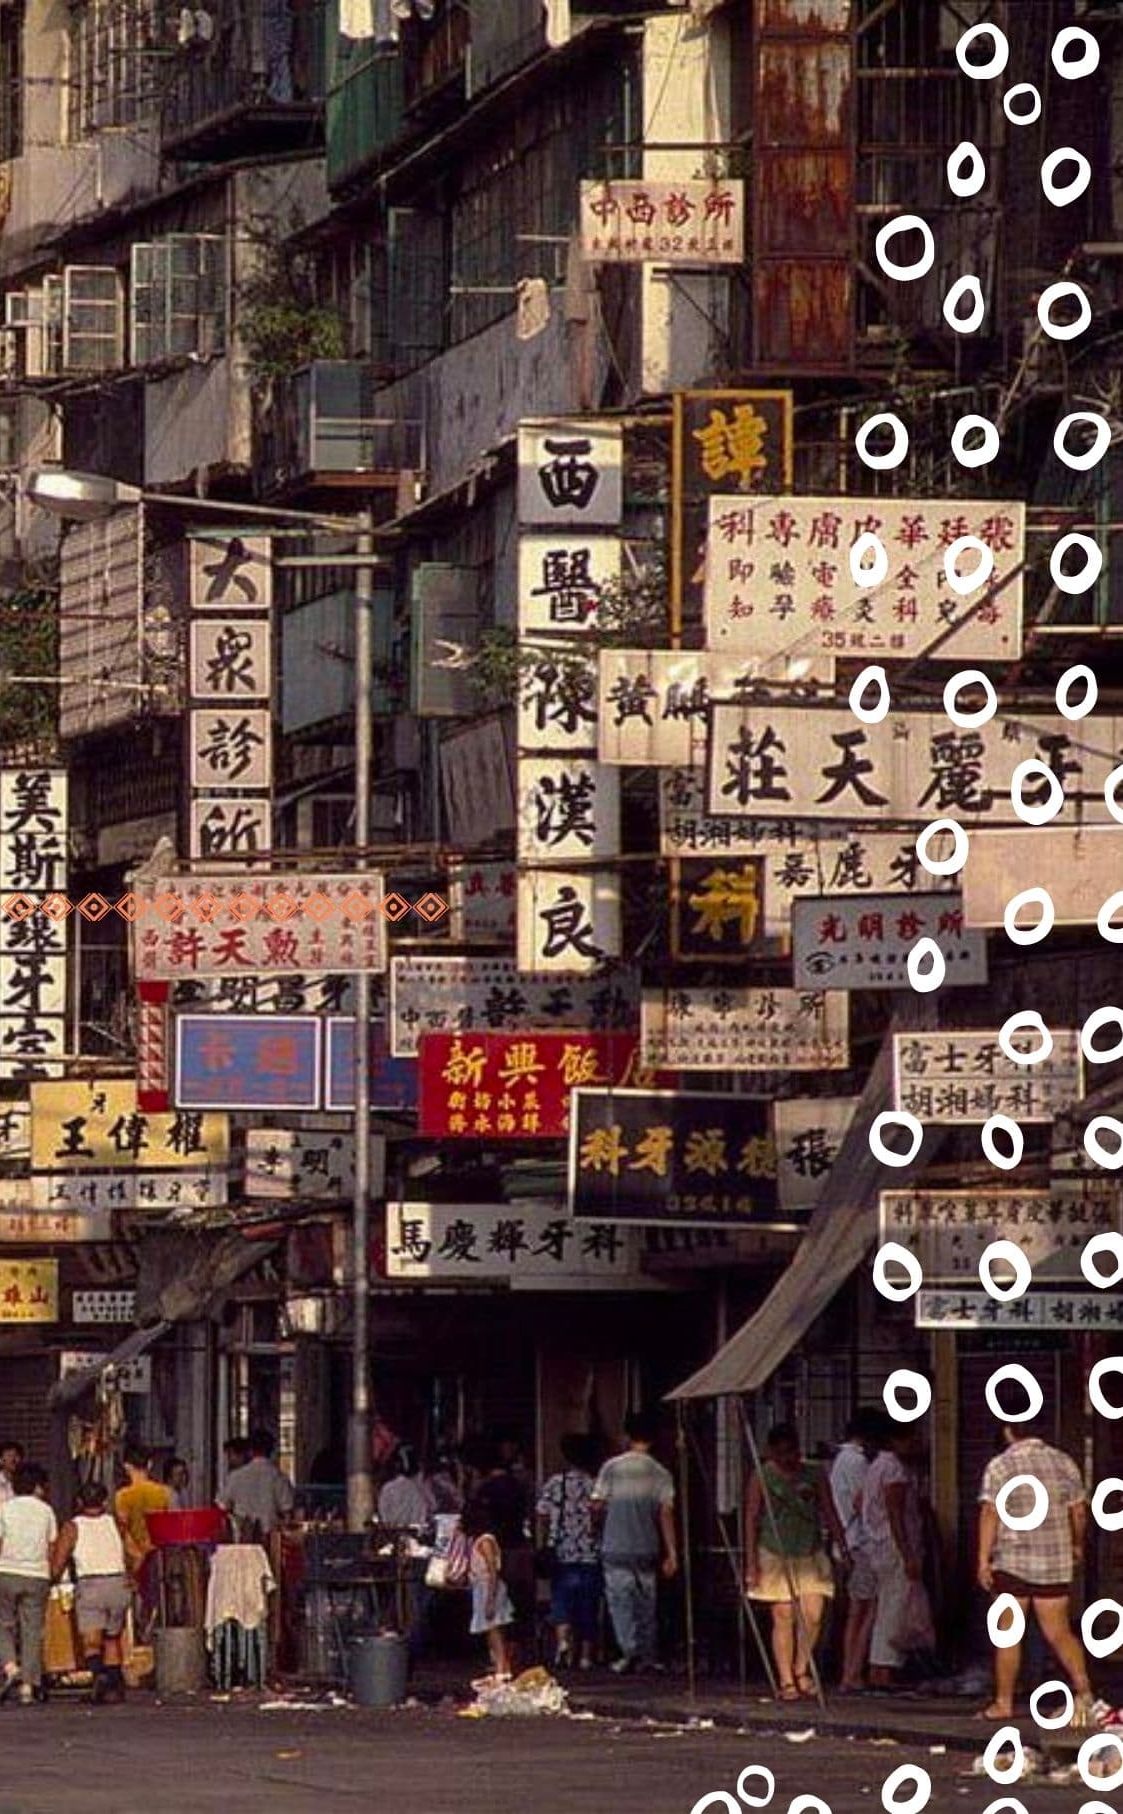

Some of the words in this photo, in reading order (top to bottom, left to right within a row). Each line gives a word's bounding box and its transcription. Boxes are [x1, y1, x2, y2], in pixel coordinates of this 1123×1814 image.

[590, 191, 735, 227] 中西診所
[818, 909, 963, 946] 光明診所
